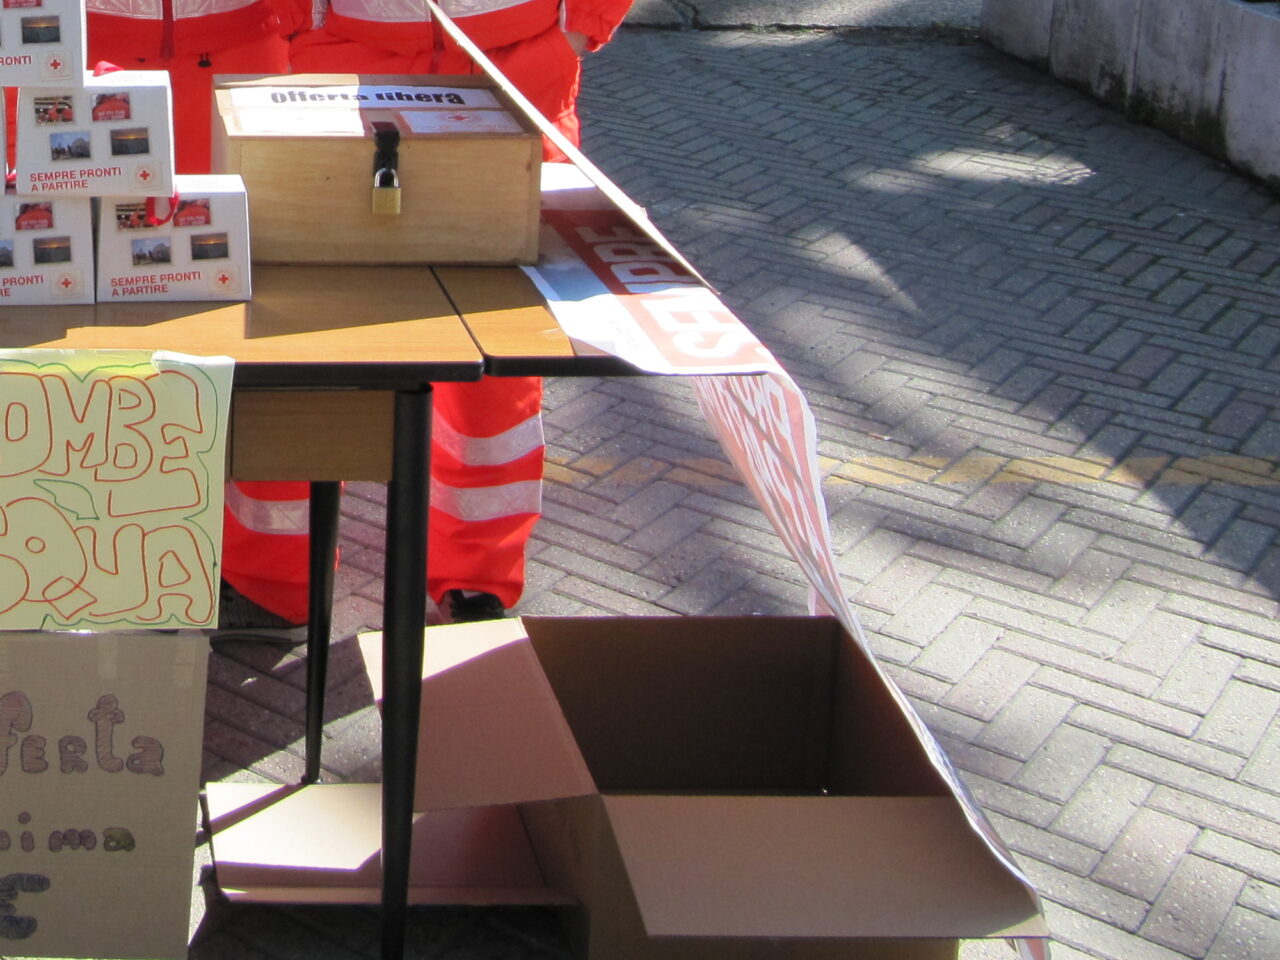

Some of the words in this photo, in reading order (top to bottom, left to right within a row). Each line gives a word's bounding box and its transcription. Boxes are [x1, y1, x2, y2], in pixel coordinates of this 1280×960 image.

[375, 90, 466, 106] libera
[30, 170, 76, 182] SEMPRE
[80, 167, 122, 180] PRONTI
[31, 184, 38, 192] A
[42, 180, 88, 191] PARTIRE
[2, 275, 44, 287] PRONTI
[111, 275, 157, 287] SEMPRE
[160, 271, 201, 283] PRONTI
[112, 289, 119, 297] A
[122, 285, 168, 297] PARTIRE
